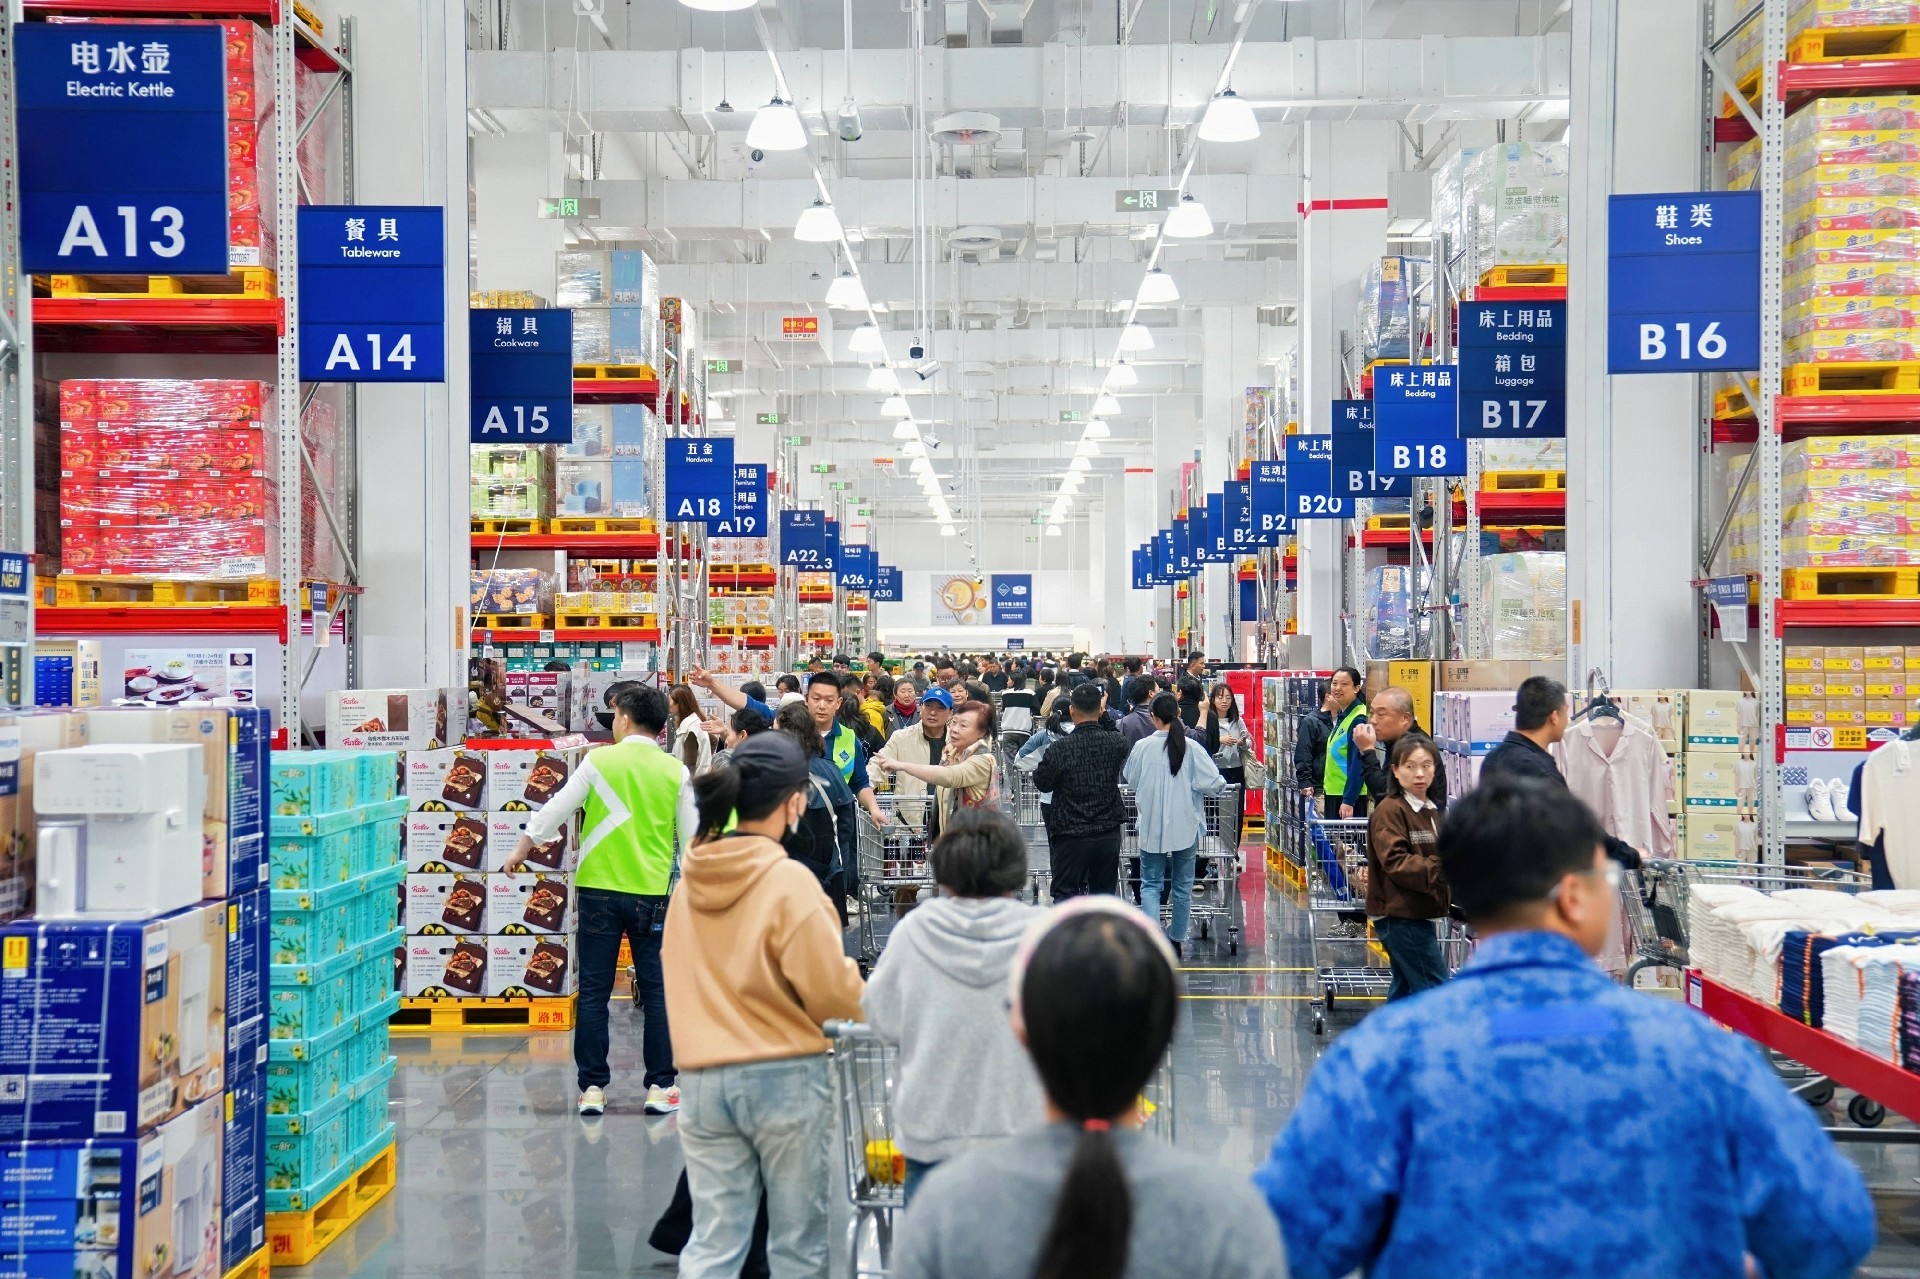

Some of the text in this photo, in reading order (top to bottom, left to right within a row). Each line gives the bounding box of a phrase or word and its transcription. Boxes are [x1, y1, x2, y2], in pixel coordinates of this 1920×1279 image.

[70, 40, 171, 75] 电水壶
[66, 80, 175, 98] Electric Kettle
[1655, 203, 1713, 229] 鞋类
[57, 205, 186, 258] A13
[344, 217, 399, 242] 餐具
[1665, 233, 1703, 246] Shoes
[340, 246, 401, 258] Tableware
[244, 281, 262, 290] ZH
[496, 316, 539, 335] 锅具
[1478, 309, 1553, 328] 床上用品
[494, 338, 540, 347] Cookware
[1496, 331, 1534, 343] Bedding
[1640, 321, 1728, 361] B16
[324, 333, 417, 371] A14
[1494, 354, 1536, 373] 箱包
[1390, 371, 1451, 387] 床上用品
[1495, 376, 1534, 387] Luggage
[1801, 376, 1816, 388] 10
[1405, 389, 1436, 399] Bedding
[481, 405, 549, 434] A15
[1482, 400, 1548, 429] B17
[687, 443, 713, 455] 五金
[1393, 444, 1447, 469] B18
[734, 468, 757, 479] 用品
[1349, 470, 1395, 491] B19
[734, 492, 757, 503] 用品
[1299, 495, 1342, 513] B20
[677, 498, 721, 517] A18
[717, 516, 756, 533] A19
[1262, 514, 1297, 530] B21
[787, 549, 818, 562] A22
[1, 573, 22, 588] NEW
[841, 574, 865, 585] A26
[1799, 580, 1813, 590] 10
[58, 588, 74, 600] ZH
[249, 588, 266, 598] ZH
[873, 589, 893, 598] A30
[537, 1010, 565, 1024] 路凯
